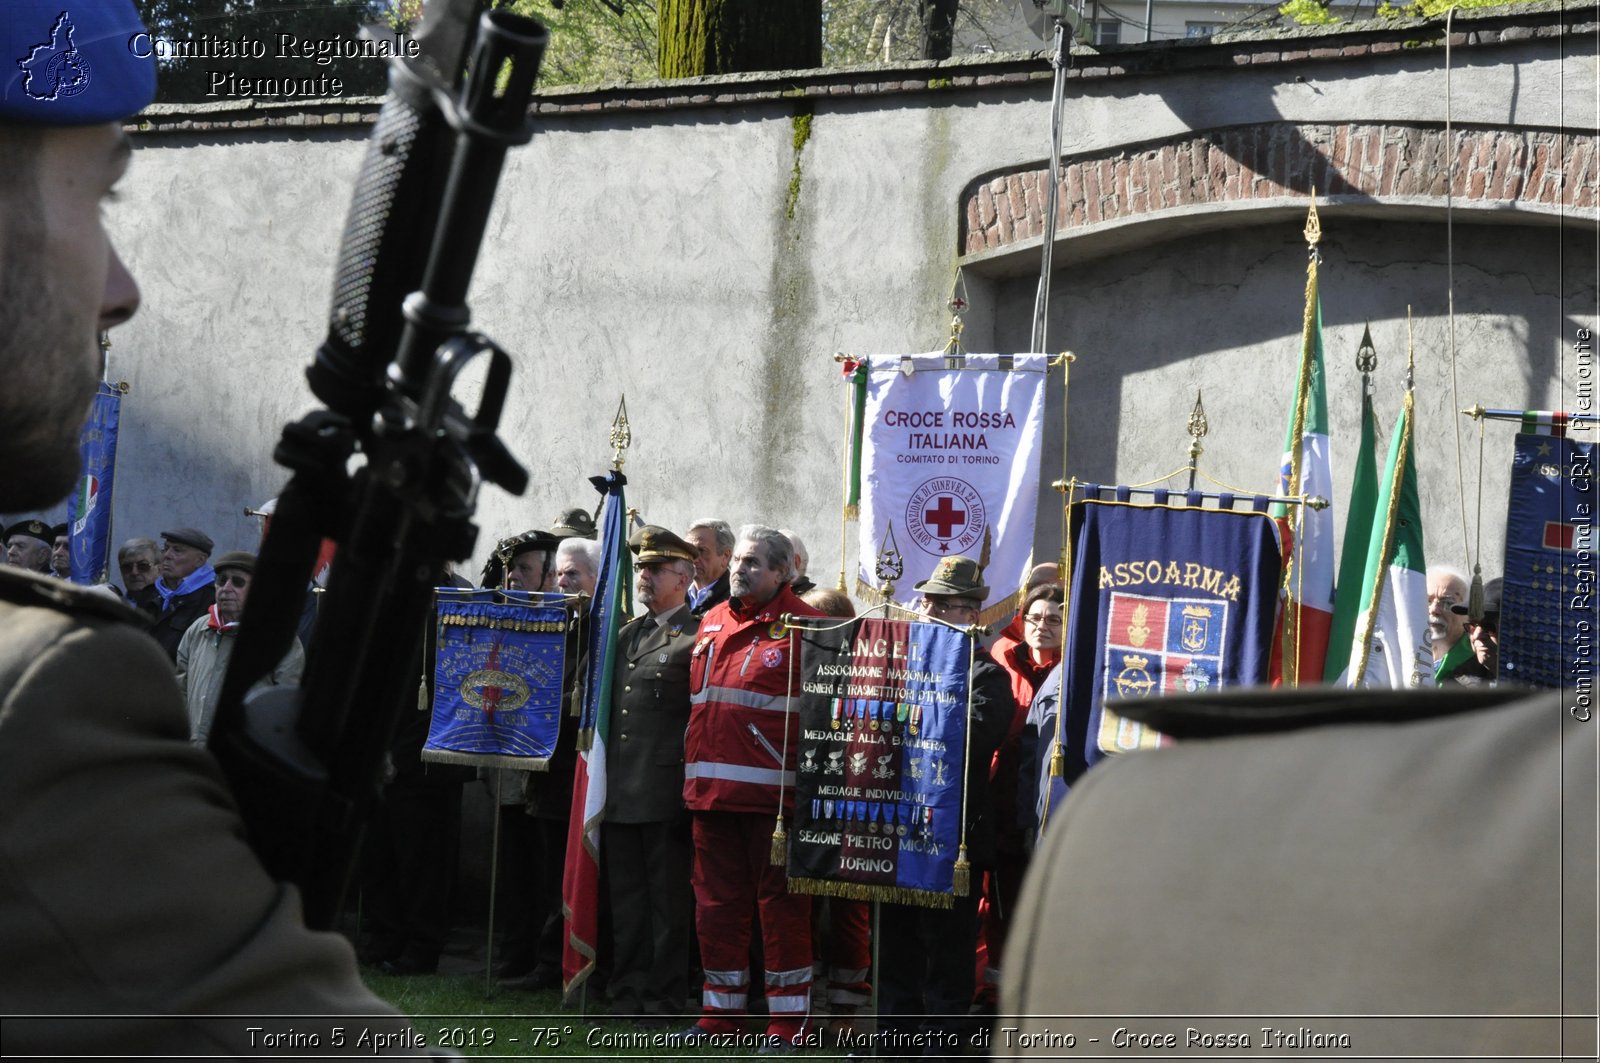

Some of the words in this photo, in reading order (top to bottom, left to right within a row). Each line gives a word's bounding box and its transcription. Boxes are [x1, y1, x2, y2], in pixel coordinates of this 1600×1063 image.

[885, 410, 943, 428] CROCE
[953, 412, 1016, 429] ROSSA
[909, 433, 988, 450] ITALIANA
[897, 454, 945, 464] COMITATO
[948, 455, 958, 464] DI
[962, 455, 1000, 465] TORINO
[908, 494, 932, 547] CONVENZIONE
[921, 487, 932, 497] DI
[931, 480, 967, 496] GINEVRA
[970, 503, 982, 533] AGOSTO
[1098, 560, 1241, 601] ASSOARMA
[816, 664, 883, 678] ASSOCIAZIONE
[887, 668, 943, 683] NAZIONALE
[803, 681, 834, 695] GENIERI
[837, 684, 843, 695] E
[847, 684, 915, 700] TRASMETTITORI
[804, 729, 854, 742] MEDAGLIE
[858, 732, 886, 745] ALLA
[892, 737, 946, 751] BANDIERA
[799, 829, 841, 846] SEZIONE
[840, 856, 893, 873] TORINO
